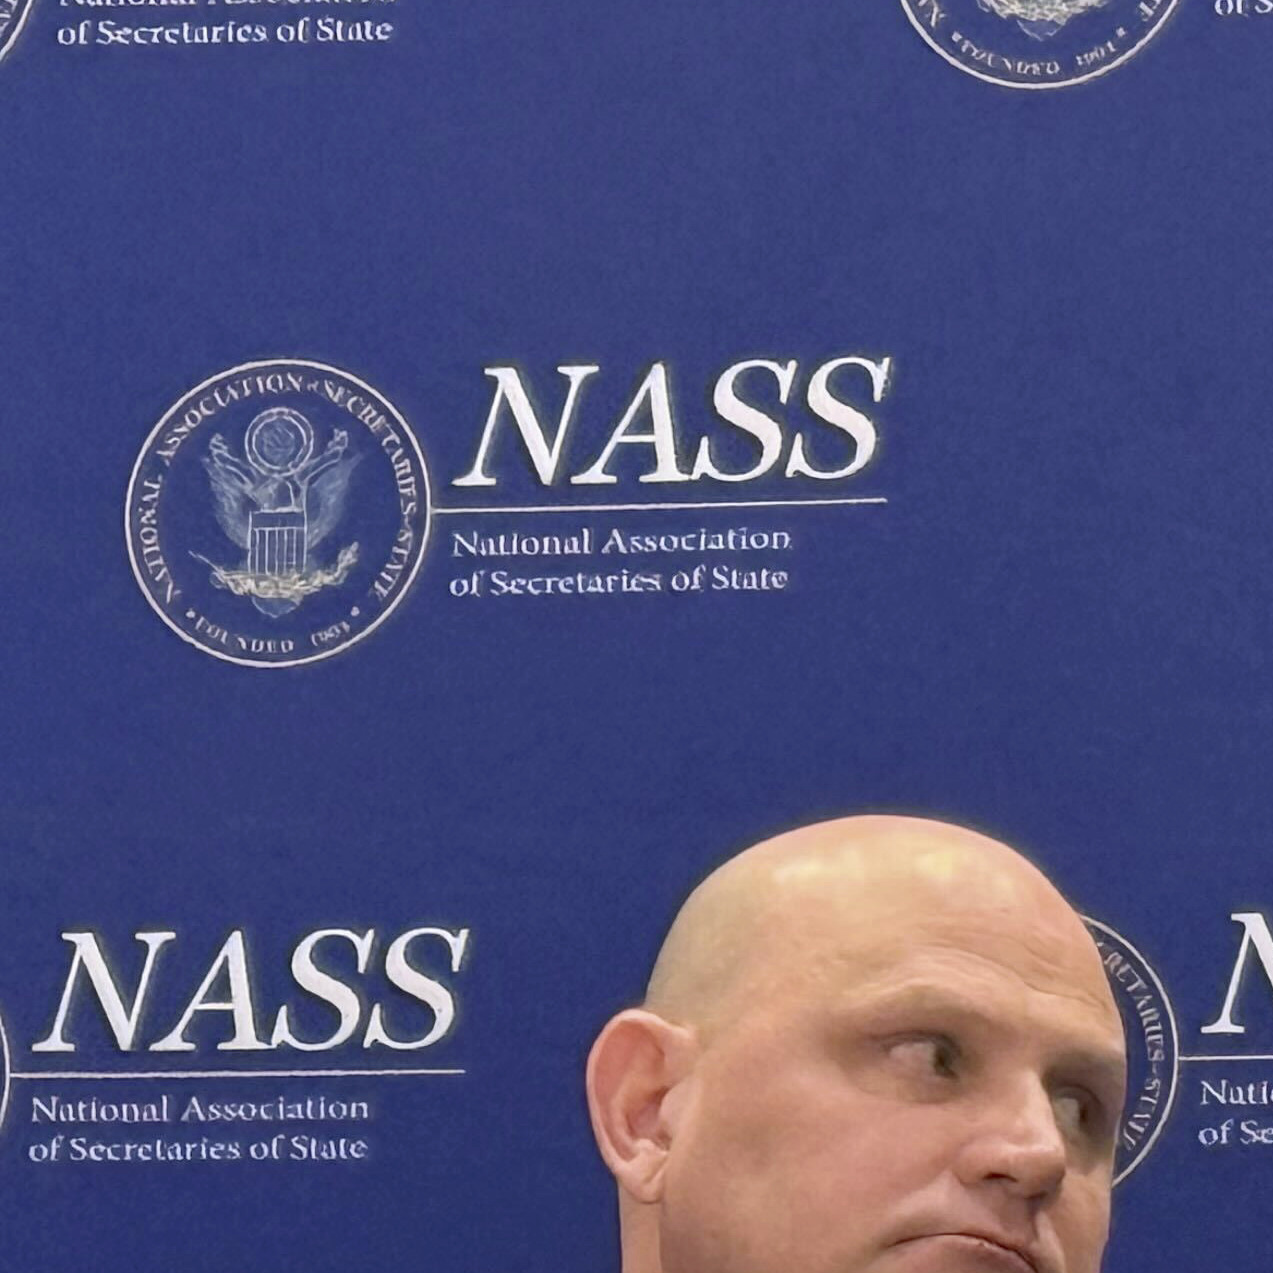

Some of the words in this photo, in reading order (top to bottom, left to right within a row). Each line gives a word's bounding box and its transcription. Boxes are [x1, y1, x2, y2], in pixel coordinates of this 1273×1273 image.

[58, 20, 90, 45] of
[96, 21, 267, 44] Secretaries
[277, 17, 310, 43] of
[317, 18, 393, 41] State
[452, 357, 890, 486] NASS
[454, 528, 590, 556] National
[602, 528, 790, 553] Association
[450, 570, 484, 596] of
[491, 569, 661, 595] Secretaries
[671, 565, 706, 590] of
[712, 566, 787, 590] State
[32, 928, 469, 1051] NASS
[32, 1095, 168, 1122] National
[181, 1097, 368, 1121] Association
[1198, 1119, 1233, 1145] of
[29, 1135, 64, 1161] of
[70, 1138, 240, 1161] Secretaries
[250, 1135, 285, 1159] of
[290, 1136, 368, 1160] State
